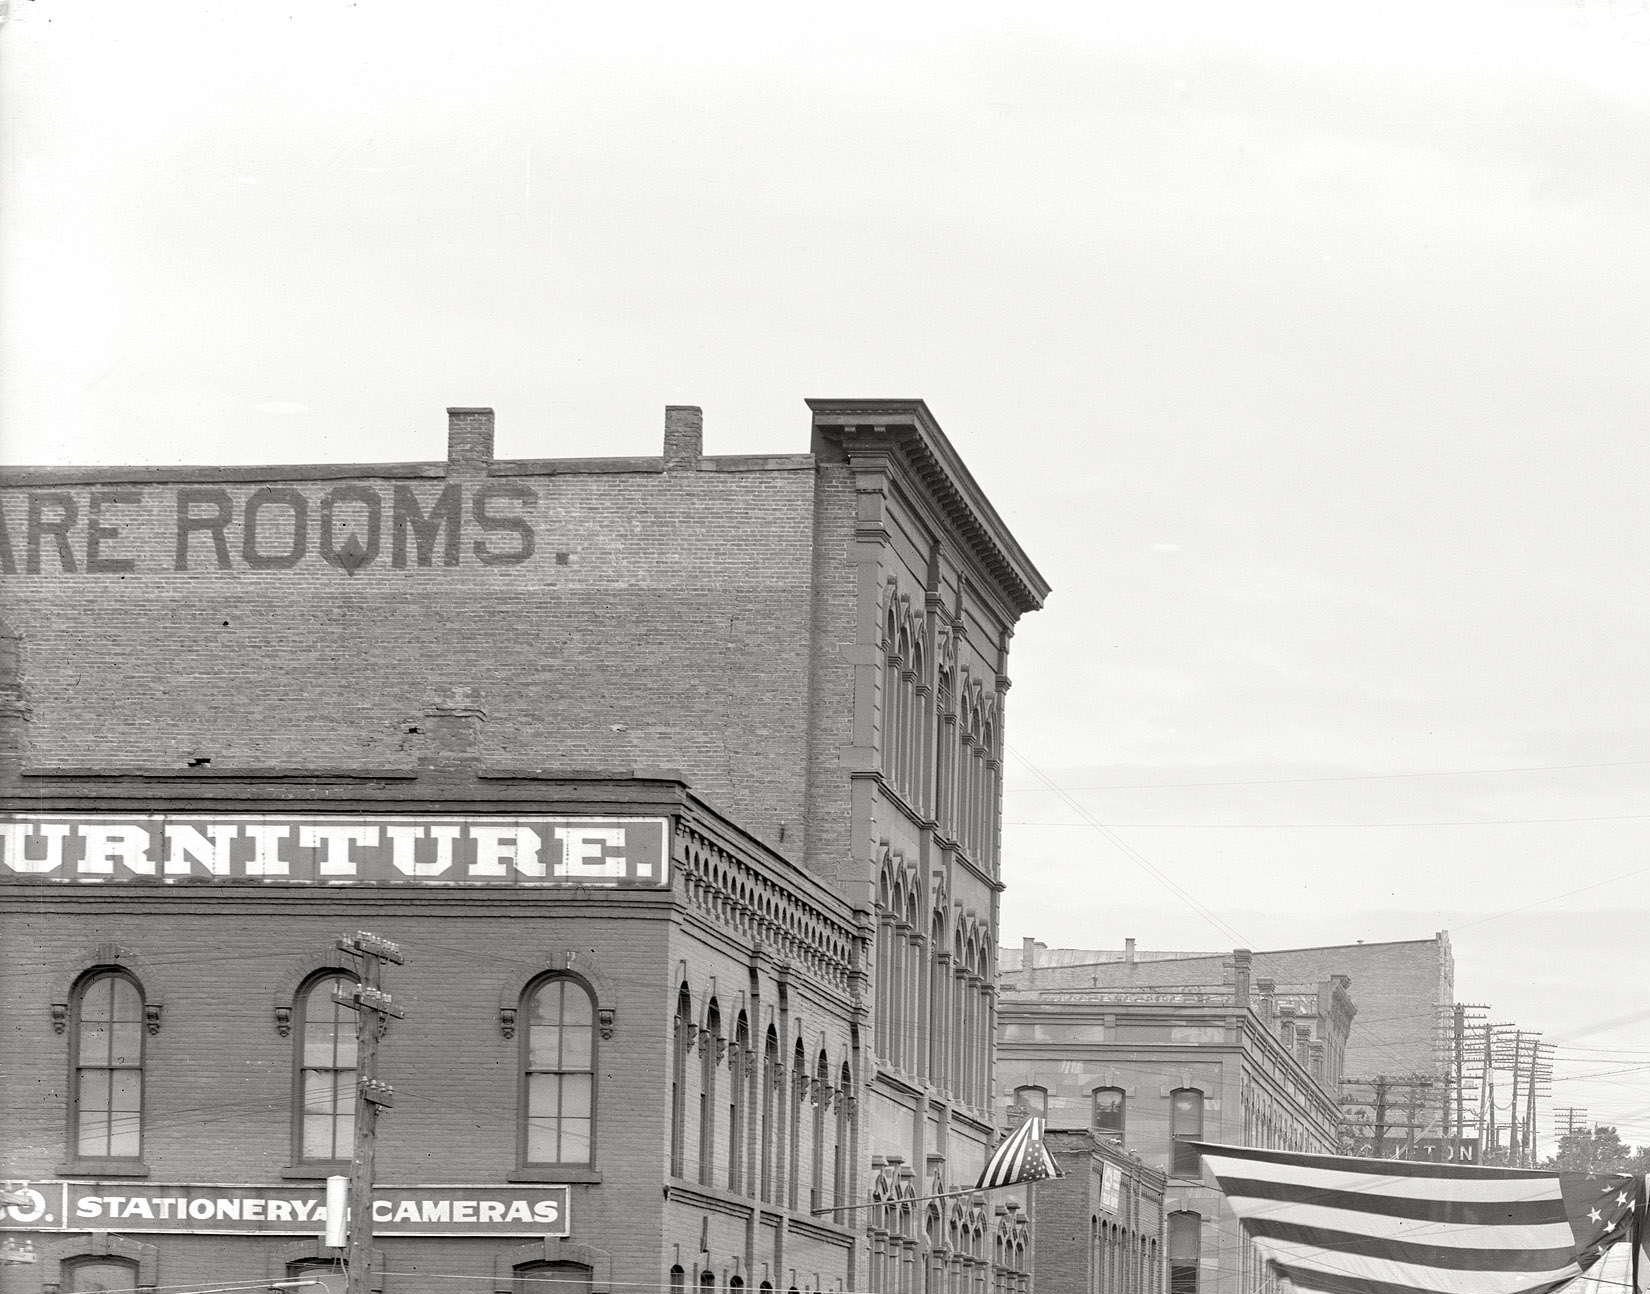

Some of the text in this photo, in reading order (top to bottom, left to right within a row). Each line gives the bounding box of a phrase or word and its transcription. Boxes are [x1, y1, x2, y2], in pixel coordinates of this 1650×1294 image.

[175, 485, 569, 576] ROOMS.
[77, 1196, 318, 1222] STATIONERY
[372, 1199, 559, 1223] CAMERAS
